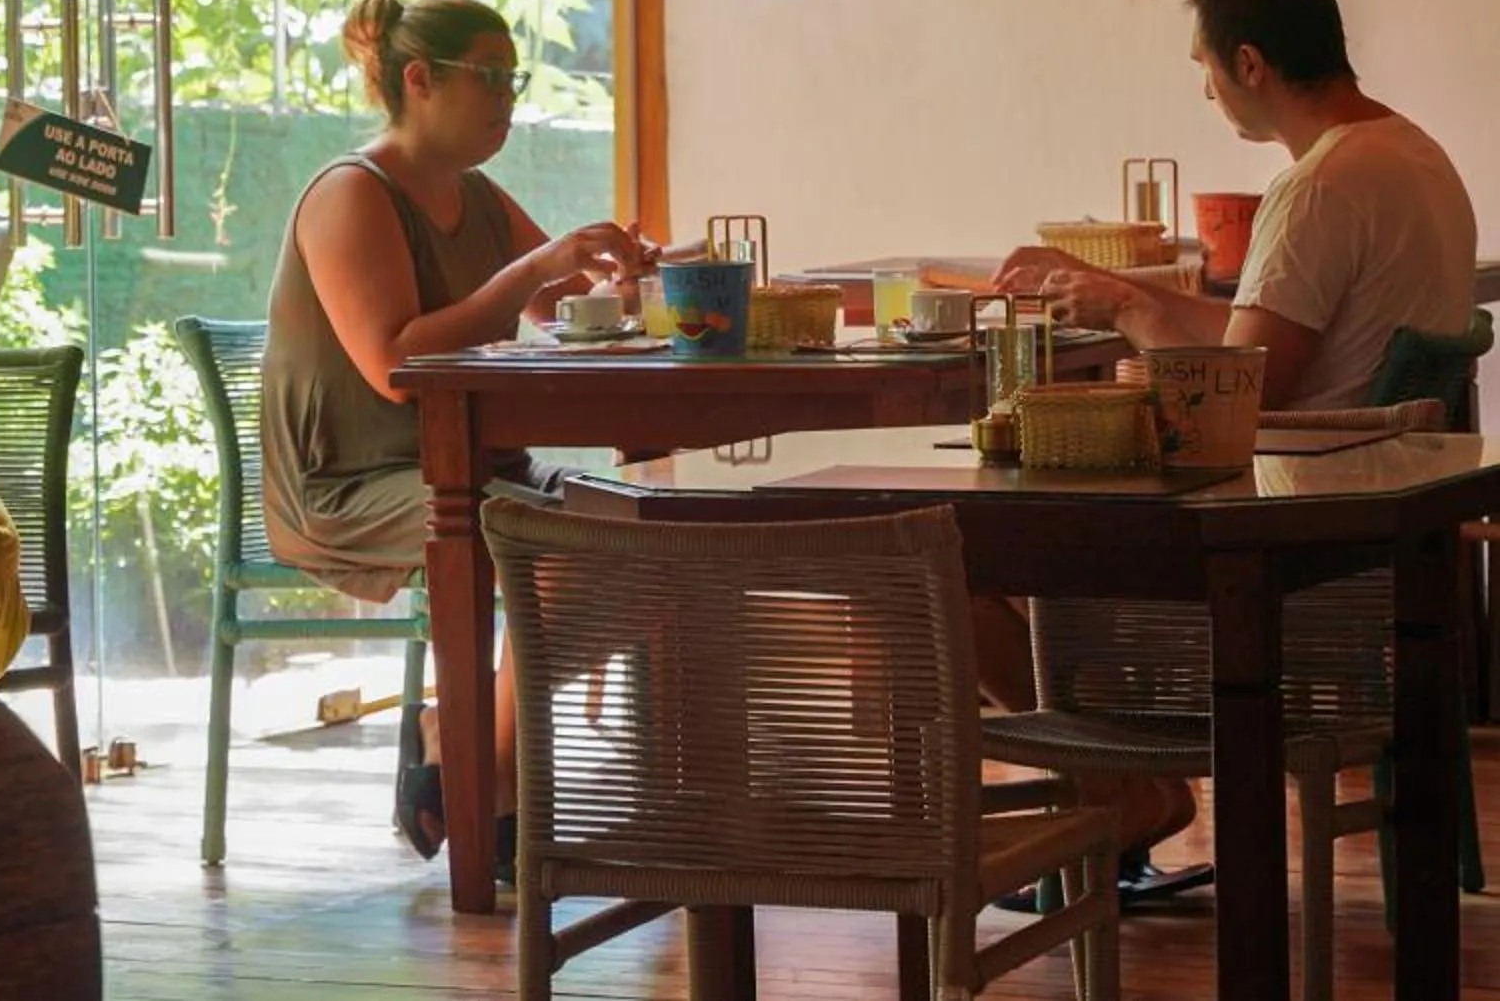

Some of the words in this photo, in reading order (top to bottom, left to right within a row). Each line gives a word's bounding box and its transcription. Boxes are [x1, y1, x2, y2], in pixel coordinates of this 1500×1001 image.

[44, 125, 73, 146] USE
[74, 135, 86, 150] A
[88, 139, 134, 167] PORTA
[55, 148, 78, 166] AO
[79, 155, 117, 179] LADO
